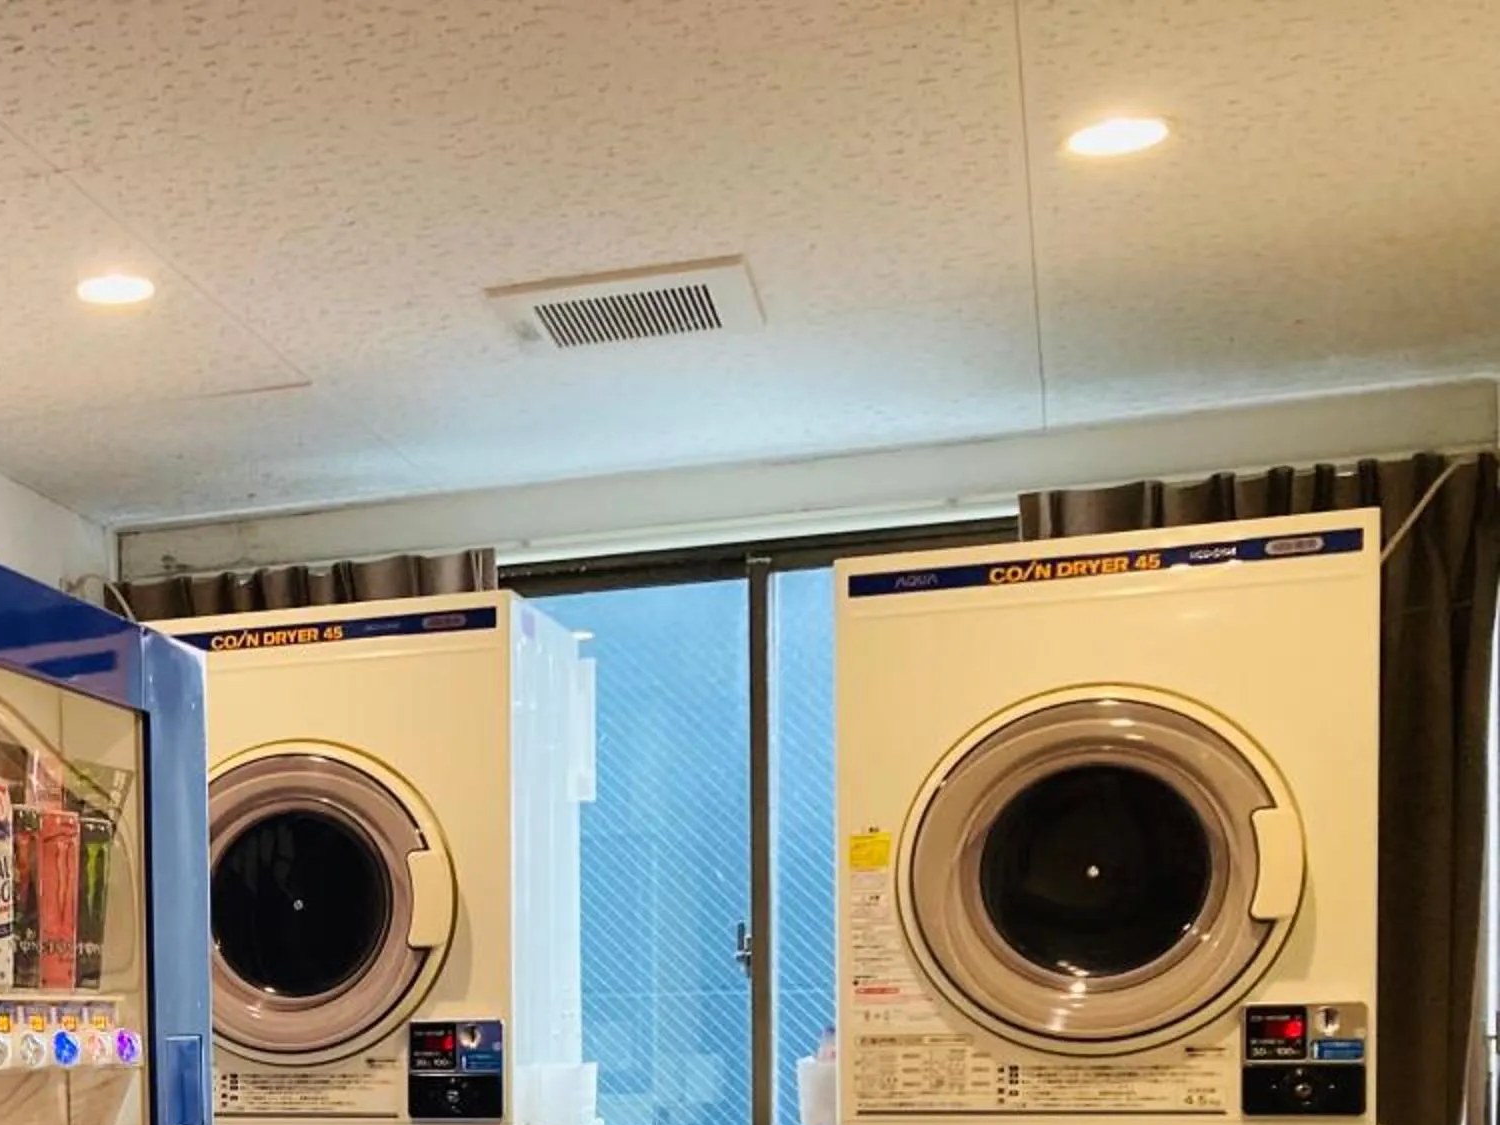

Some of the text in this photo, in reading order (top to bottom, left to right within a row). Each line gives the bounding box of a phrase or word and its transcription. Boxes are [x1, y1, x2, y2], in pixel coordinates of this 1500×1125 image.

[1056, 555, 1129, 578] DRYER
[1133, 552, 1161, 572] 45
[893, 573, 939, 589] AQUA
[263, 627, 319, 647] DRYER
[323, 625, 343, 641] 45
